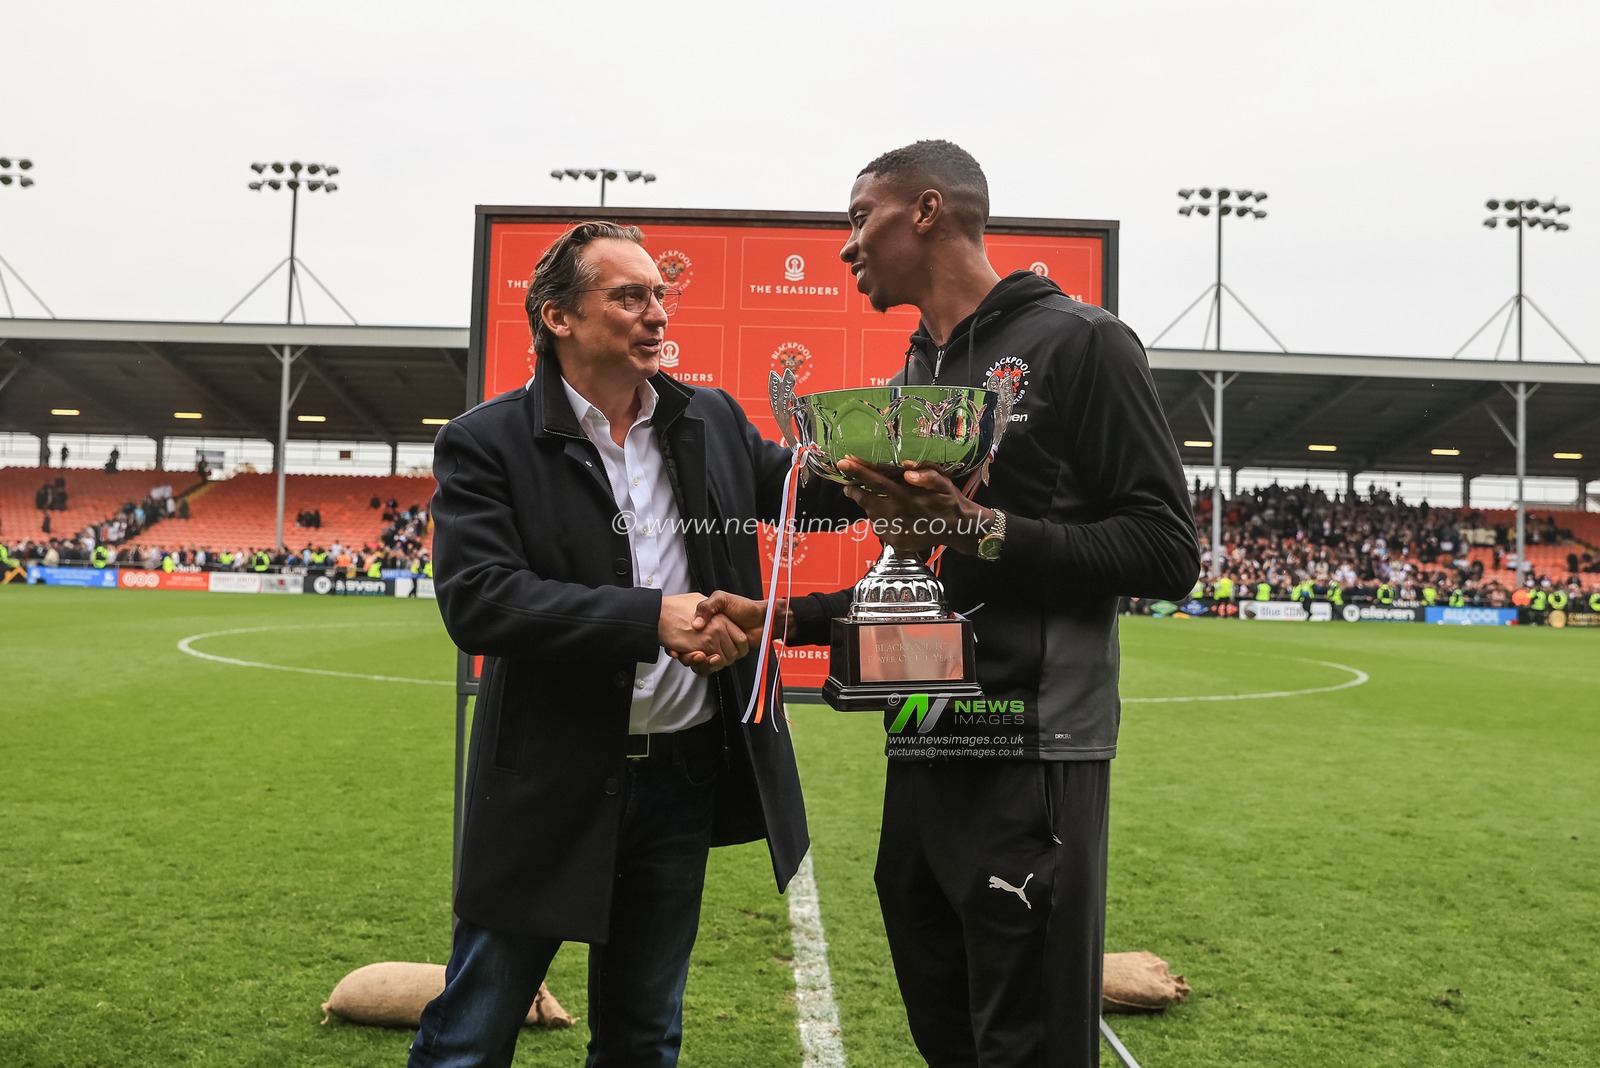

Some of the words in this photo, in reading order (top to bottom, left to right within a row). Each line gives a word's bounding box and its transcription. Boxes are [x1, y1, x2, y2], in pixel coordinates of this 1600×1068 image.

[655, 250, 692, 268] LACKPOOL
[507, 280, 529, 288] THE
[750, 285, 771, 294] THE
[776, 286, 839, 296] SEASIDERS
[771, 342, 812, 360] BLACKPOOL
[986, 357, 1030, 376] BLACKPOOL
[672, 373, 713, 382] SIDERS
[336, 580, 386, 592] eeven
[1360, 606, 1415, 619] eleven
